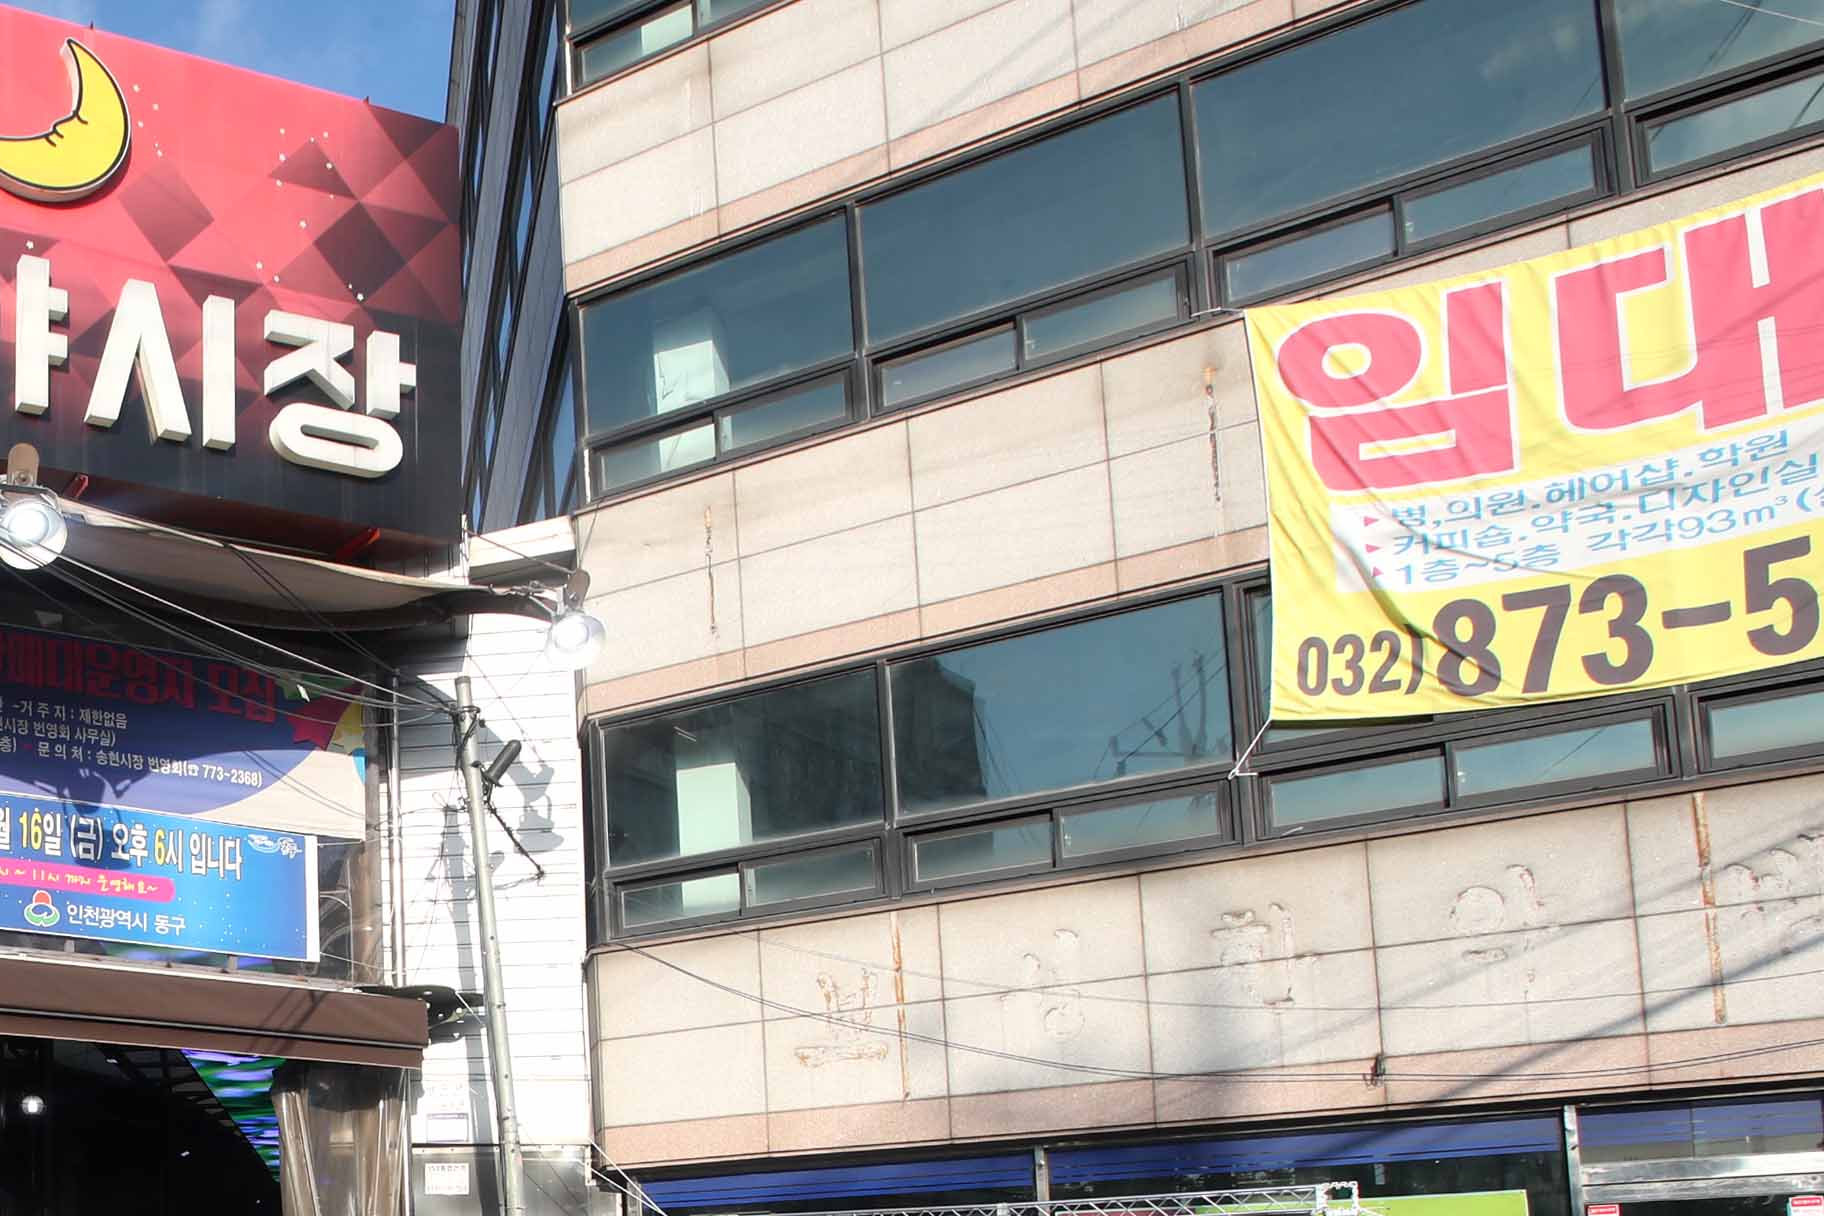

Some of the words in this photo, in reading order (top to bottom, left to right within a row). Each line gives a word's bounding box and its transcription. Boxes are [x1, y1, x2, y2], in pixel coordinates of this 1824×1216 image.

[1276, 187, 1824, 492] 임대
[1395, 543, 1561, 585] 1층~5층
[207, 662, 276, 724] 모집
[32, 721, 71, 742] 번영회
[74, 726, 117, 747] 사무실)
[79, 708, 128, 730] 제한없음
[95, 750, 145, 771] 송현시장
[202, 764, 264, 789] 773-2368)
[18, 808, 63, 857] 16일
[69, 813, 104, 861] (금)
[111, 823, 149, 868] 오후
[154, 829, 184, 874] 6시
[189, 832, 244, 880] 입니다
[66, 904, 148, 933] 인천광역시
[153, 914, 187, 937] 동구
